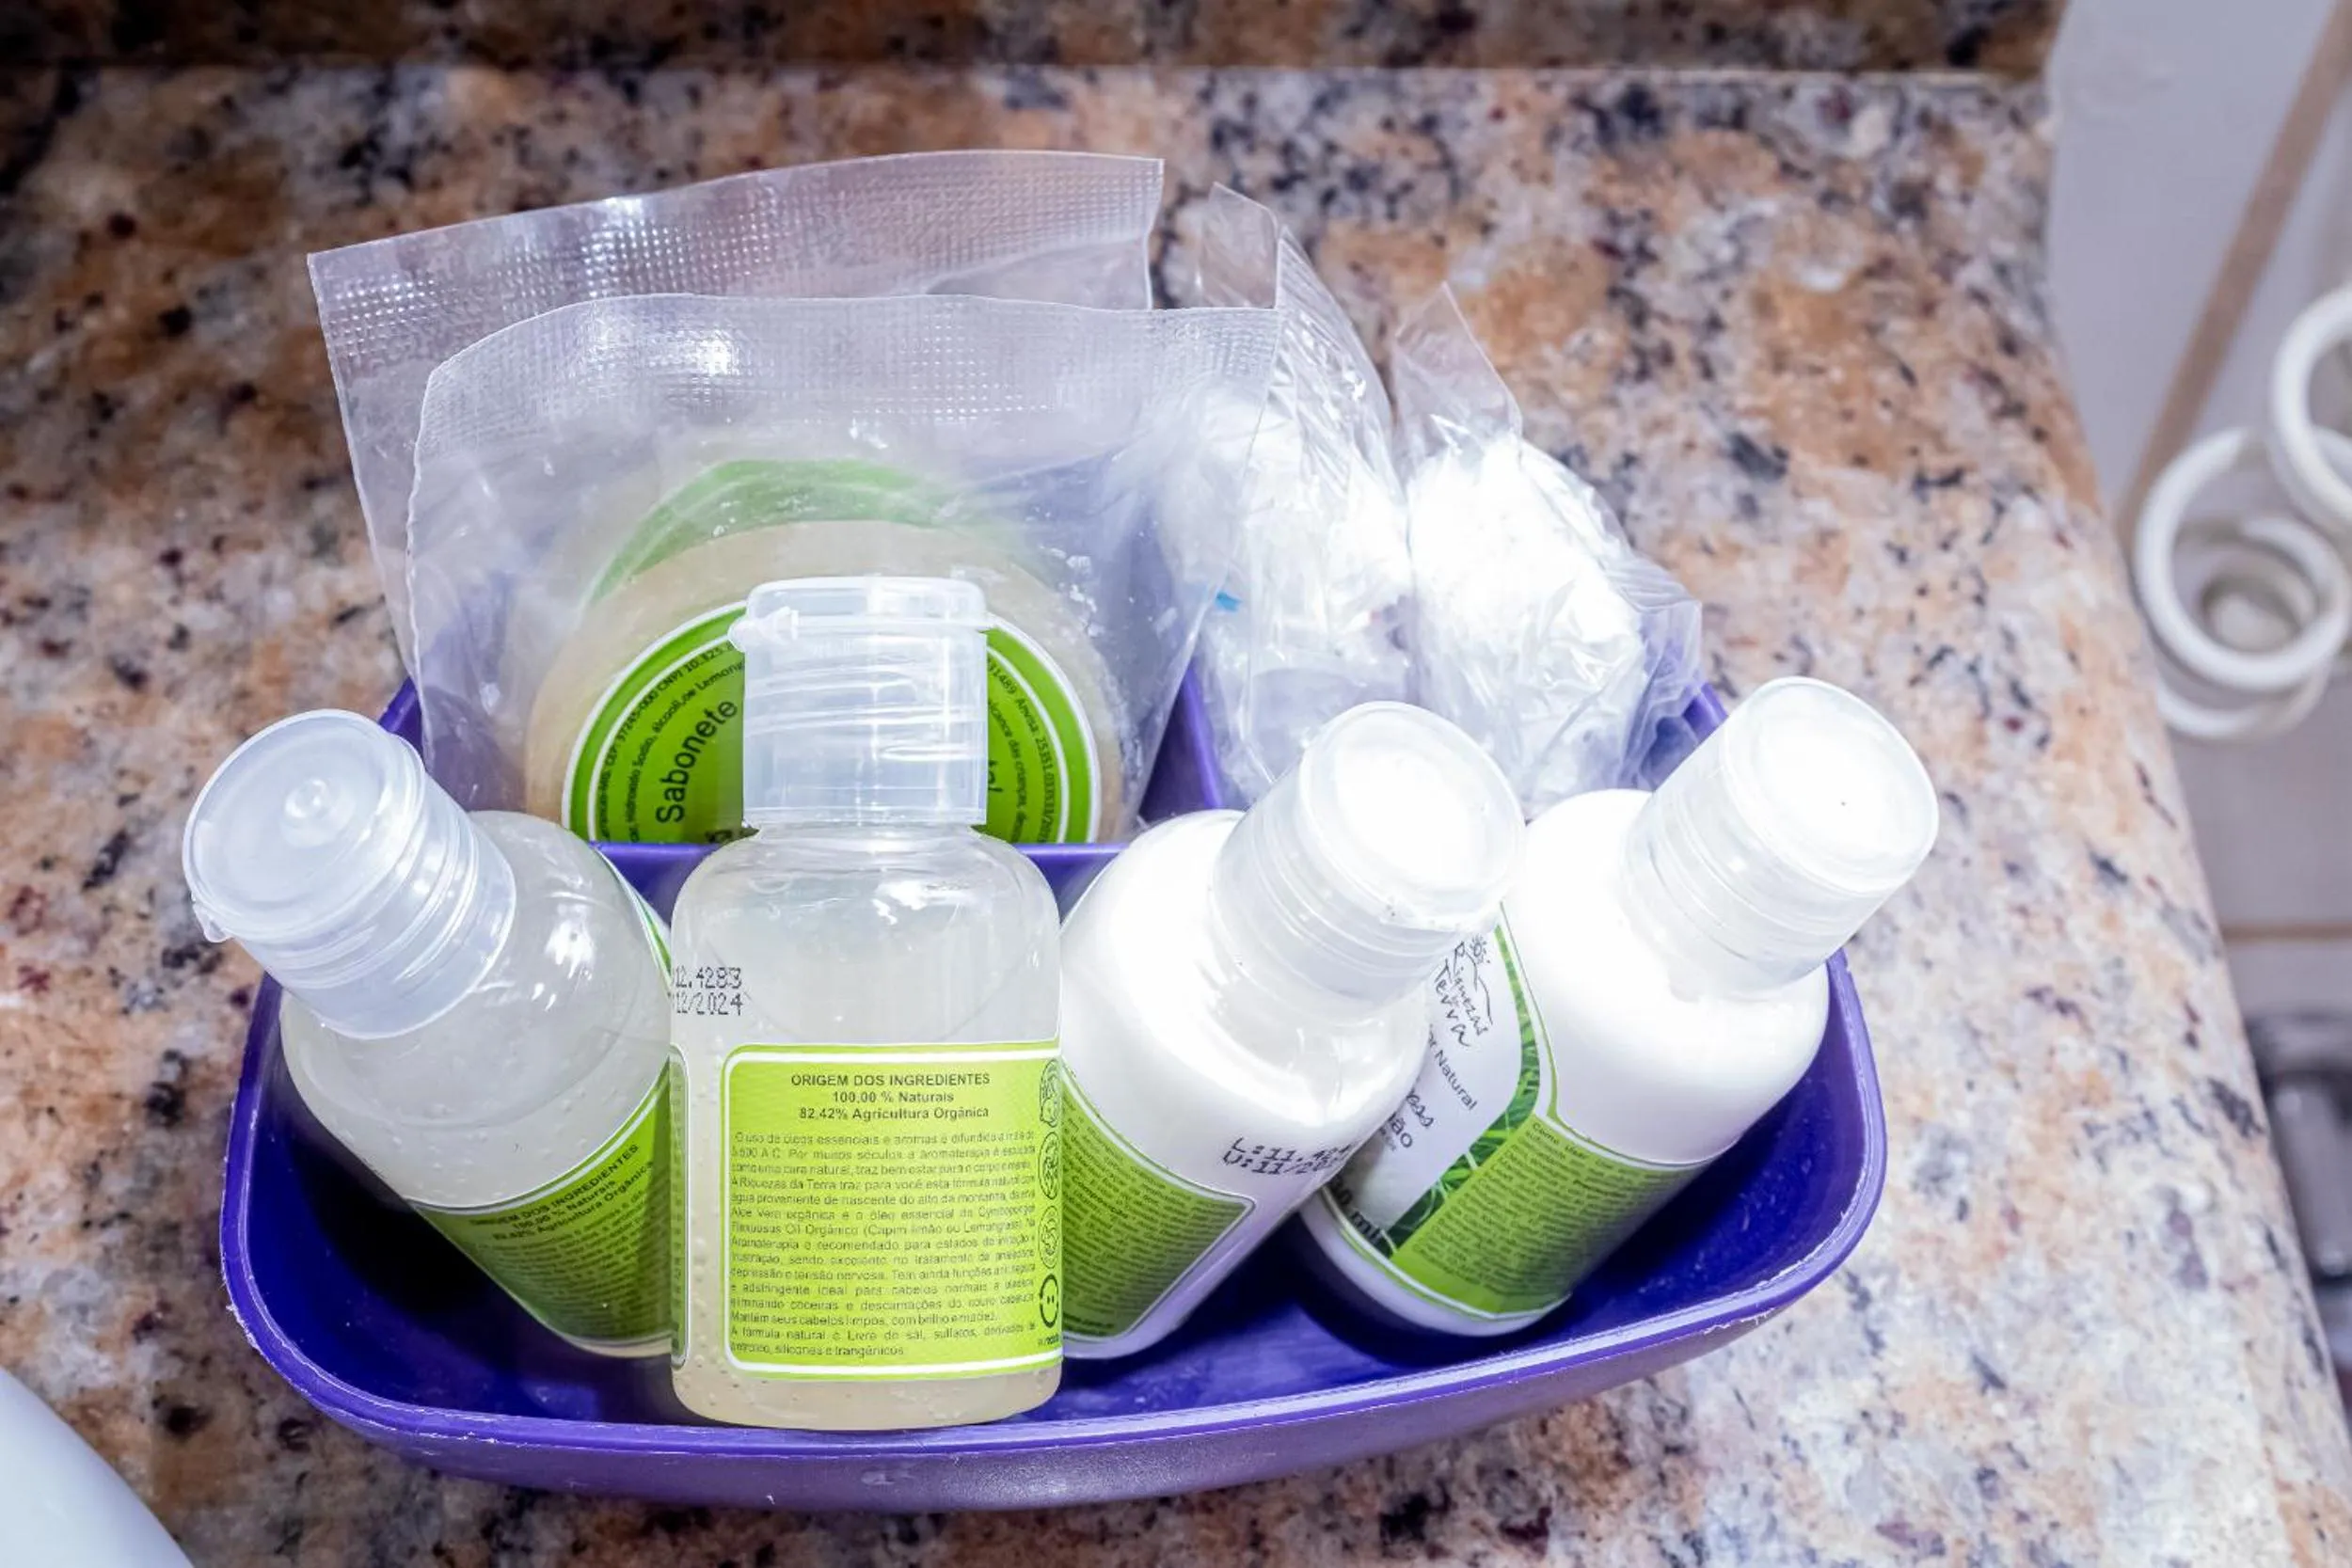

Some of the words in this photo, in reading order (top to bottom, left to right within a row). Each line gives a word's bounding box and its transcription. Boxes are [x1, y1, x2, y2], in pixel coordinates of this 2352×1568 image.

[656, 701, 738, 823] Sabonete
[791, 1074, 848, 1086] ORIGEM
[853, 1074, 885, 1086] DOS
[889, 1073, 990, 1086] INGREDIENTES
[881, 1091, 894, 1103] %
[898, 1091, 954, 1103] Naturais
[1434, 1049, 1478, 1111] Natural
[852, 1107, 930, 1122] Agricultura
[934, 1106, 989, 1122] Orgânica
[551, 1143, 639, 1210] INGREDIENTES
